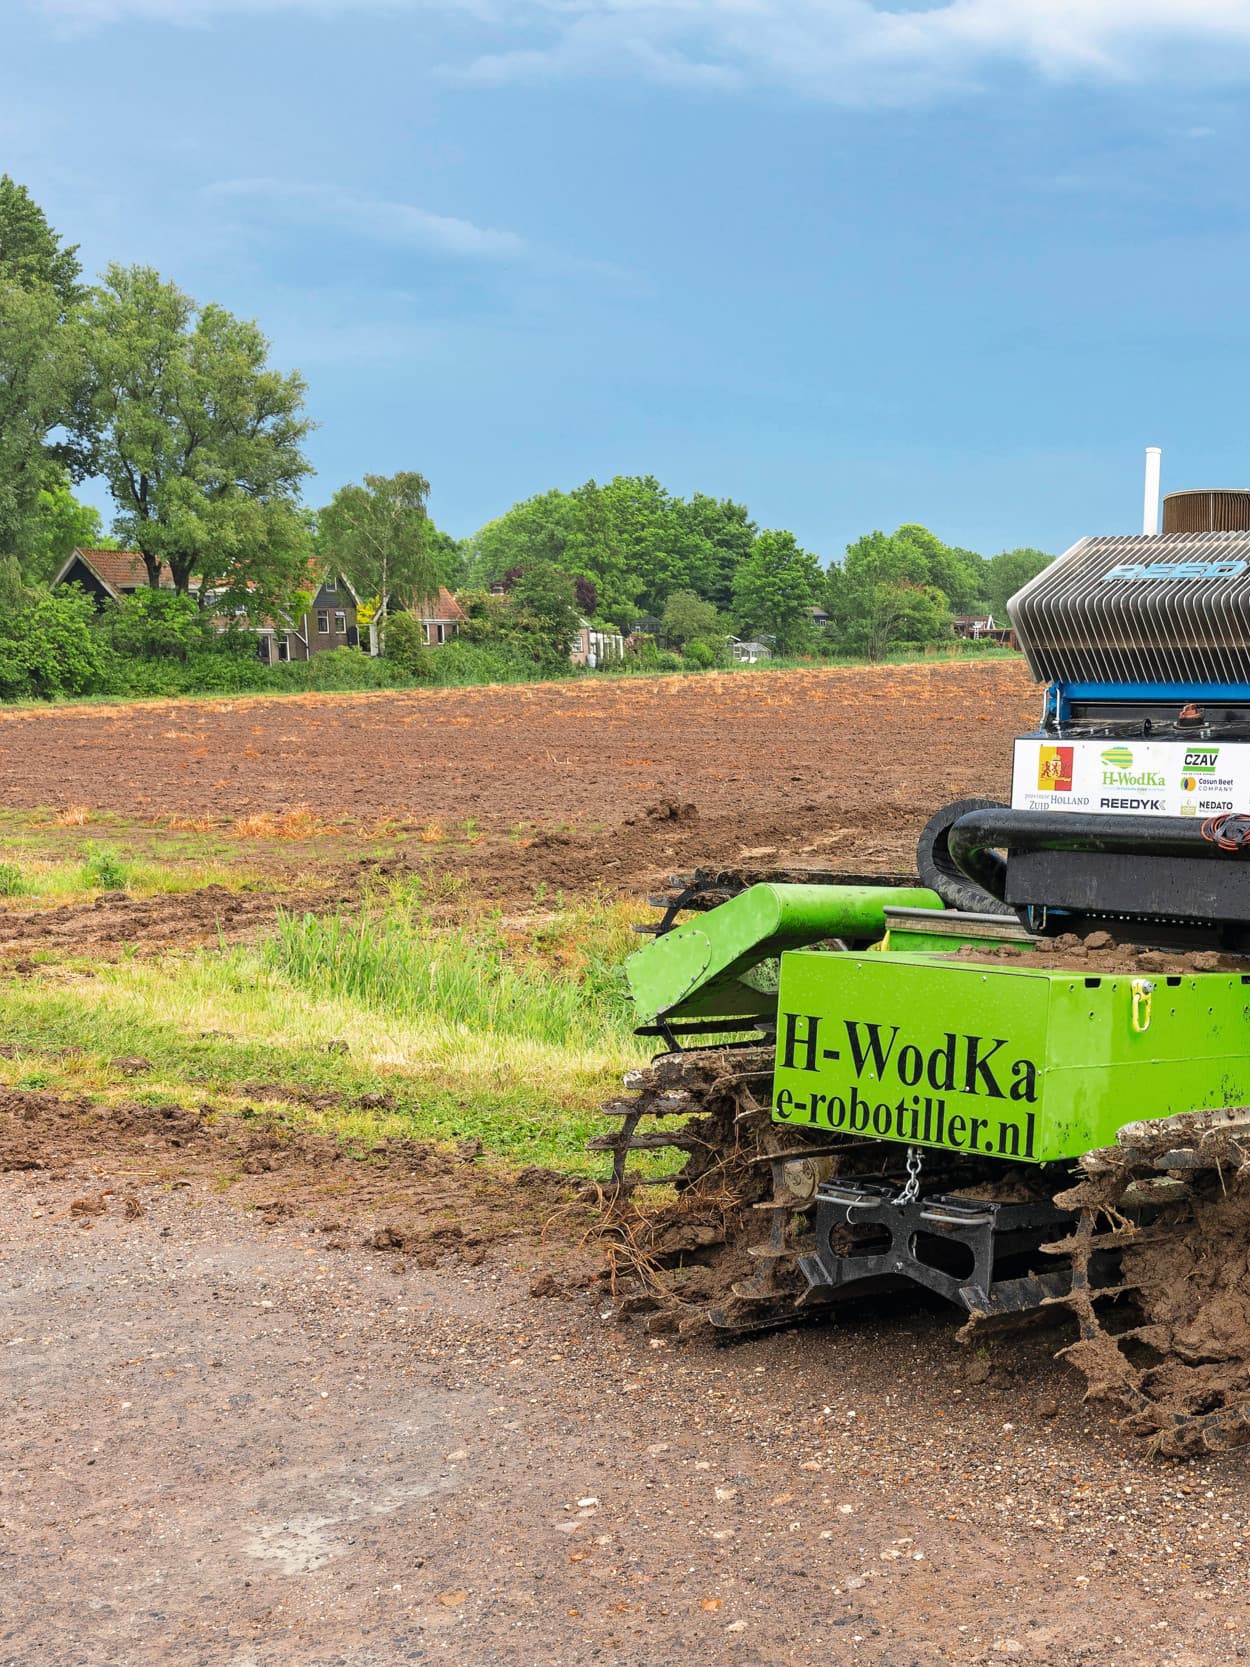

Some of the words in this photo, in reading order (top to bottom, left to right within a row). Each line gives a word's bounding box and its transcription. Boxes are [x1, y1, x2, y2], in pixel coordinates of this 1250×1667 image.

[1184, 754, 1218, 766] CZAV
[1102, 771, 1166, 787] H-WodKa
[1198, 777, 1218, 785] Cosun
[1218, 778, 1234, 786] Beet
[1100, 798, 1160, 810] REEDYK
[1199, 801, 1233, 810] NEDATO
[779, 1012, 1038, 1103] H-WodKa
[775, 1086, 1035, 1159] e-robotiller.nl
